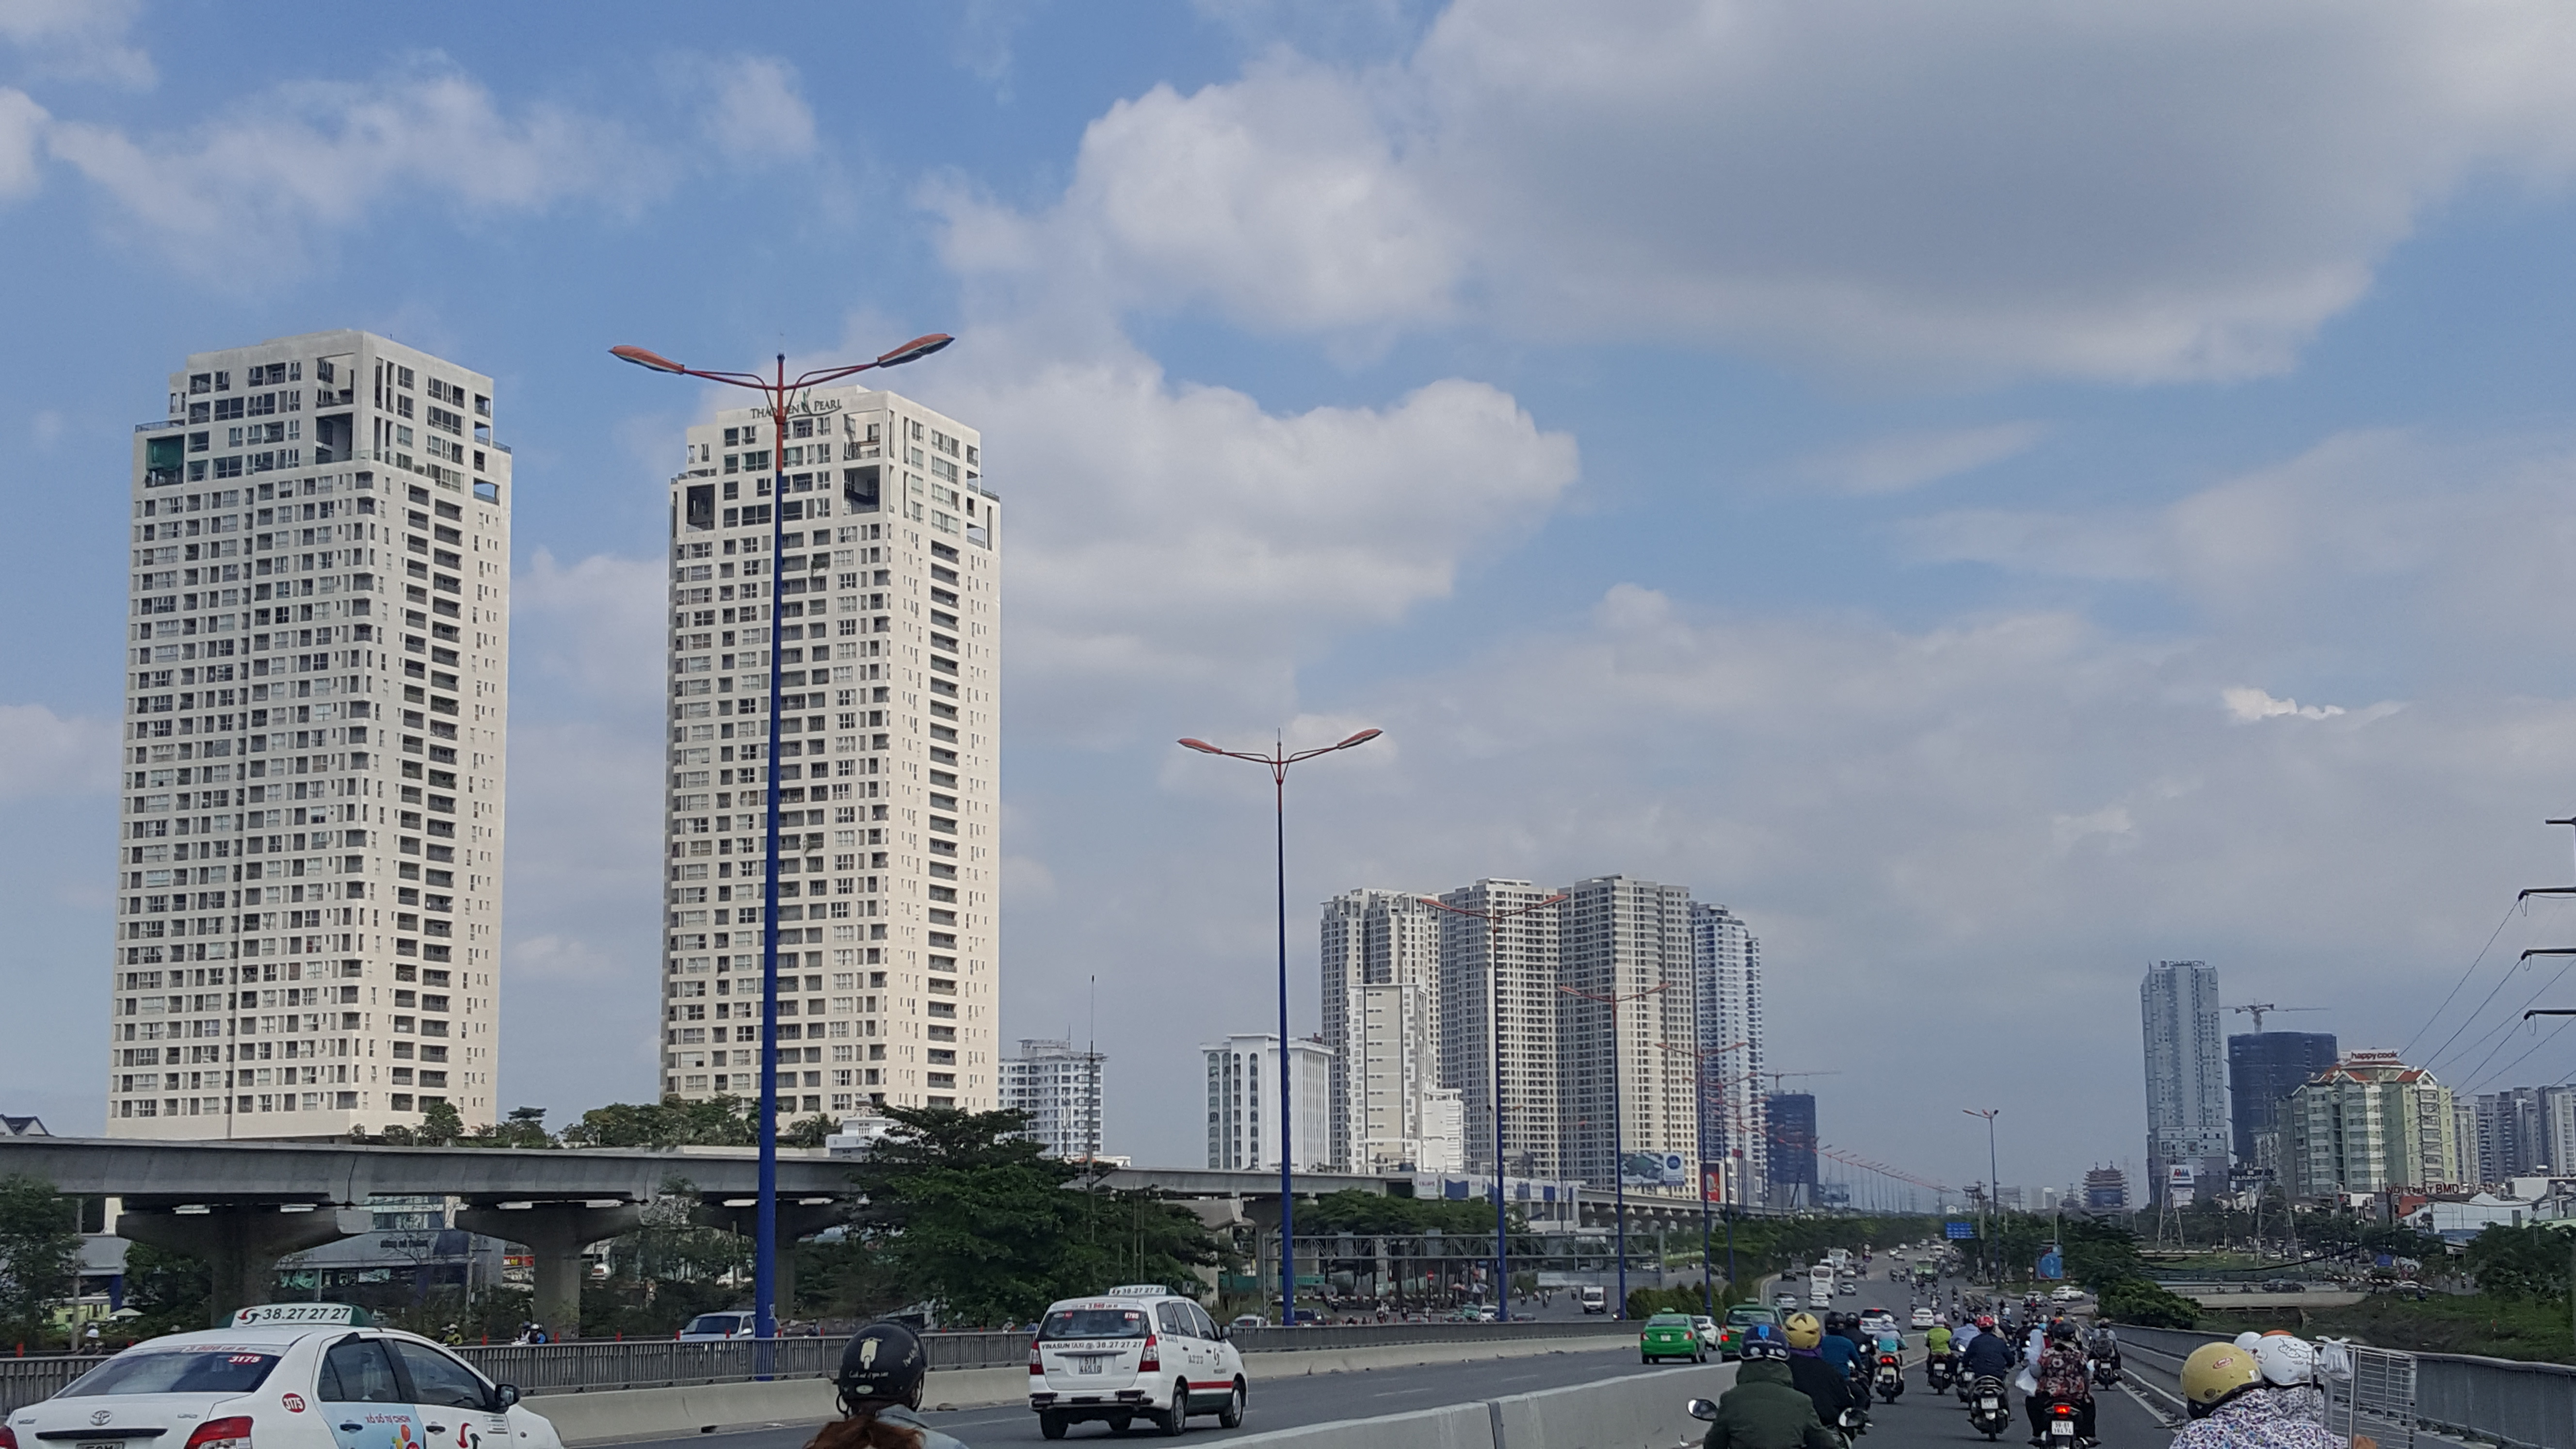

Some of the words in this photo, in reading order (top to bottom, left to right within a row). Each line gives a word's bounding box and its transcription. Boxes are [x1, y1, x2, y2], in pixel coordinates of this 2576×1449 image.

[814, 399, 841, 412] PEARL
[2435, 1183, 2460, 1194] BMD
[262, 1308, 307, 1320] 38.27
[308, 1308, 330, 1320] 27
[330, 1307, 351, 1320] 27
[228, 1355, 262, 1364] 3175
[283, 1397, 304, 1410] 3175
